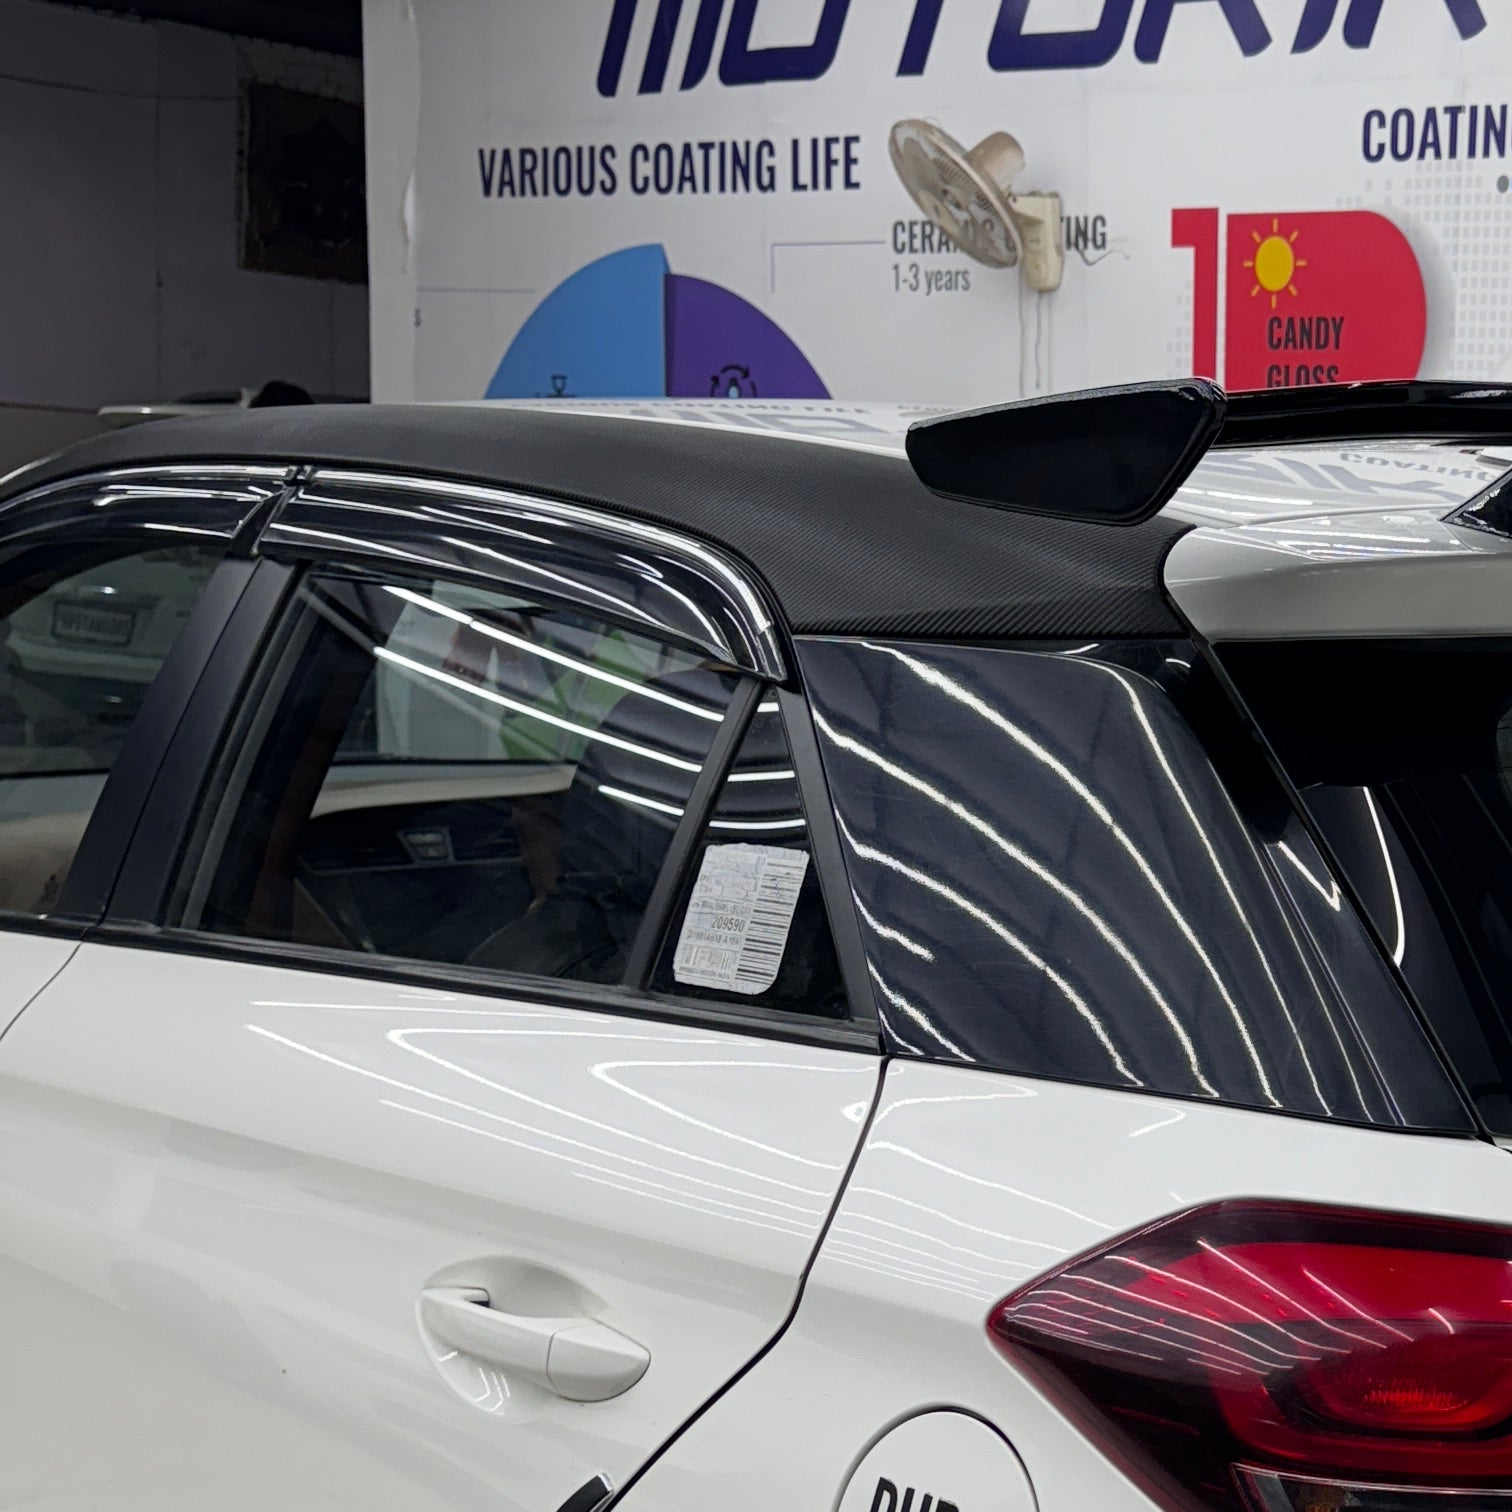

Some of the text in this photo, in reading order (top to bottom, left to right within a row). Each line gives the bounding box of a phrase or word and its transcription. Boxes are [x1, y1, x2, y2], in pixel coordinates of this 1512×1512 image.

[477, 136, 862, 198] VARIOUS COATING LIFE
[892, 264, 971, 296] 1-3 years
[1266, 316, 1345, 350] CANDY
